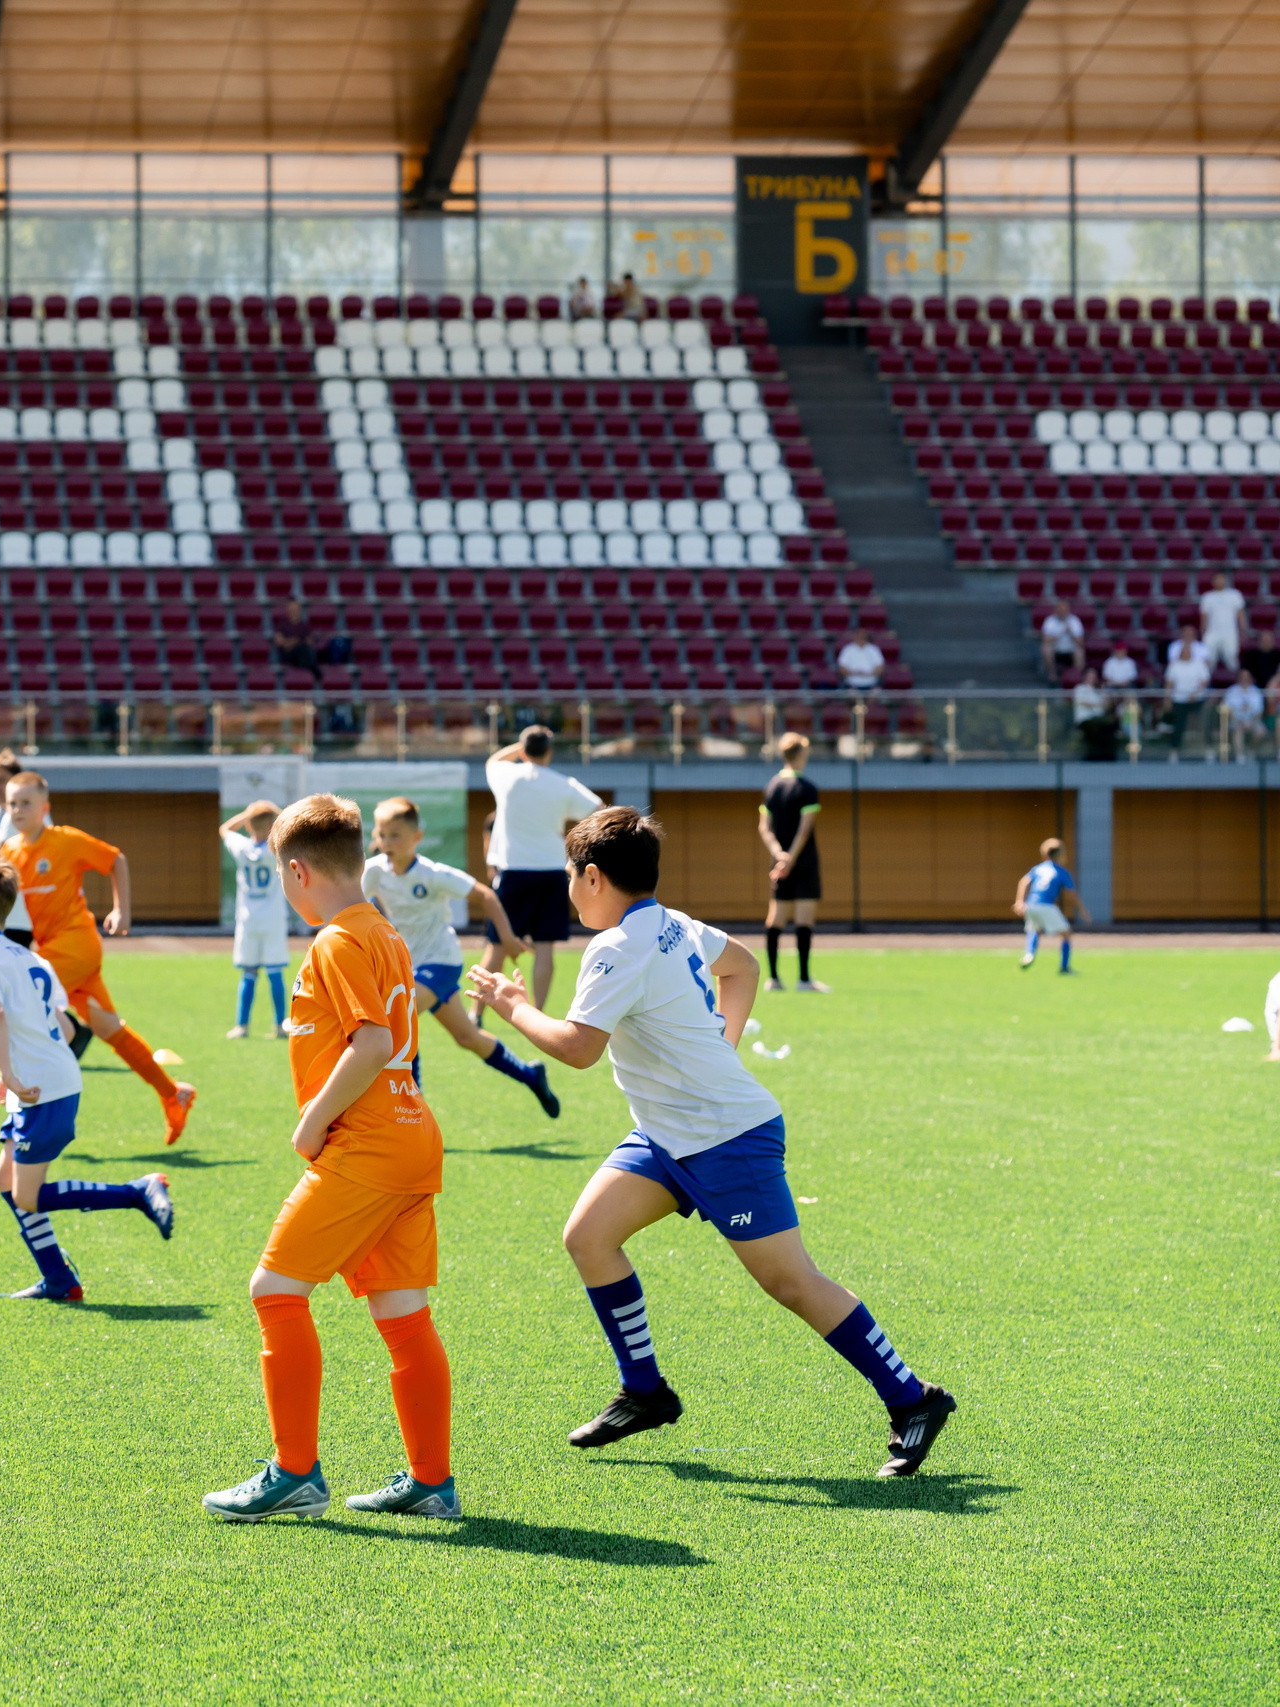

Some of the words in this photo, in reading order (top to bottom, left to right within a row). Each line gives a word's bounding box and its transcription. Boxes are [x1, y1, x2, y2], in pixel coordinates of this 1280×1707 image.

[744, 174, 862, 200] ТРИБУНА
[795, 201, 858, 294] Б
[28, 966, 62, 1041] 2
[730, 1211, 752, 1226] FN
[908, 1412, 929, 1426] F50
